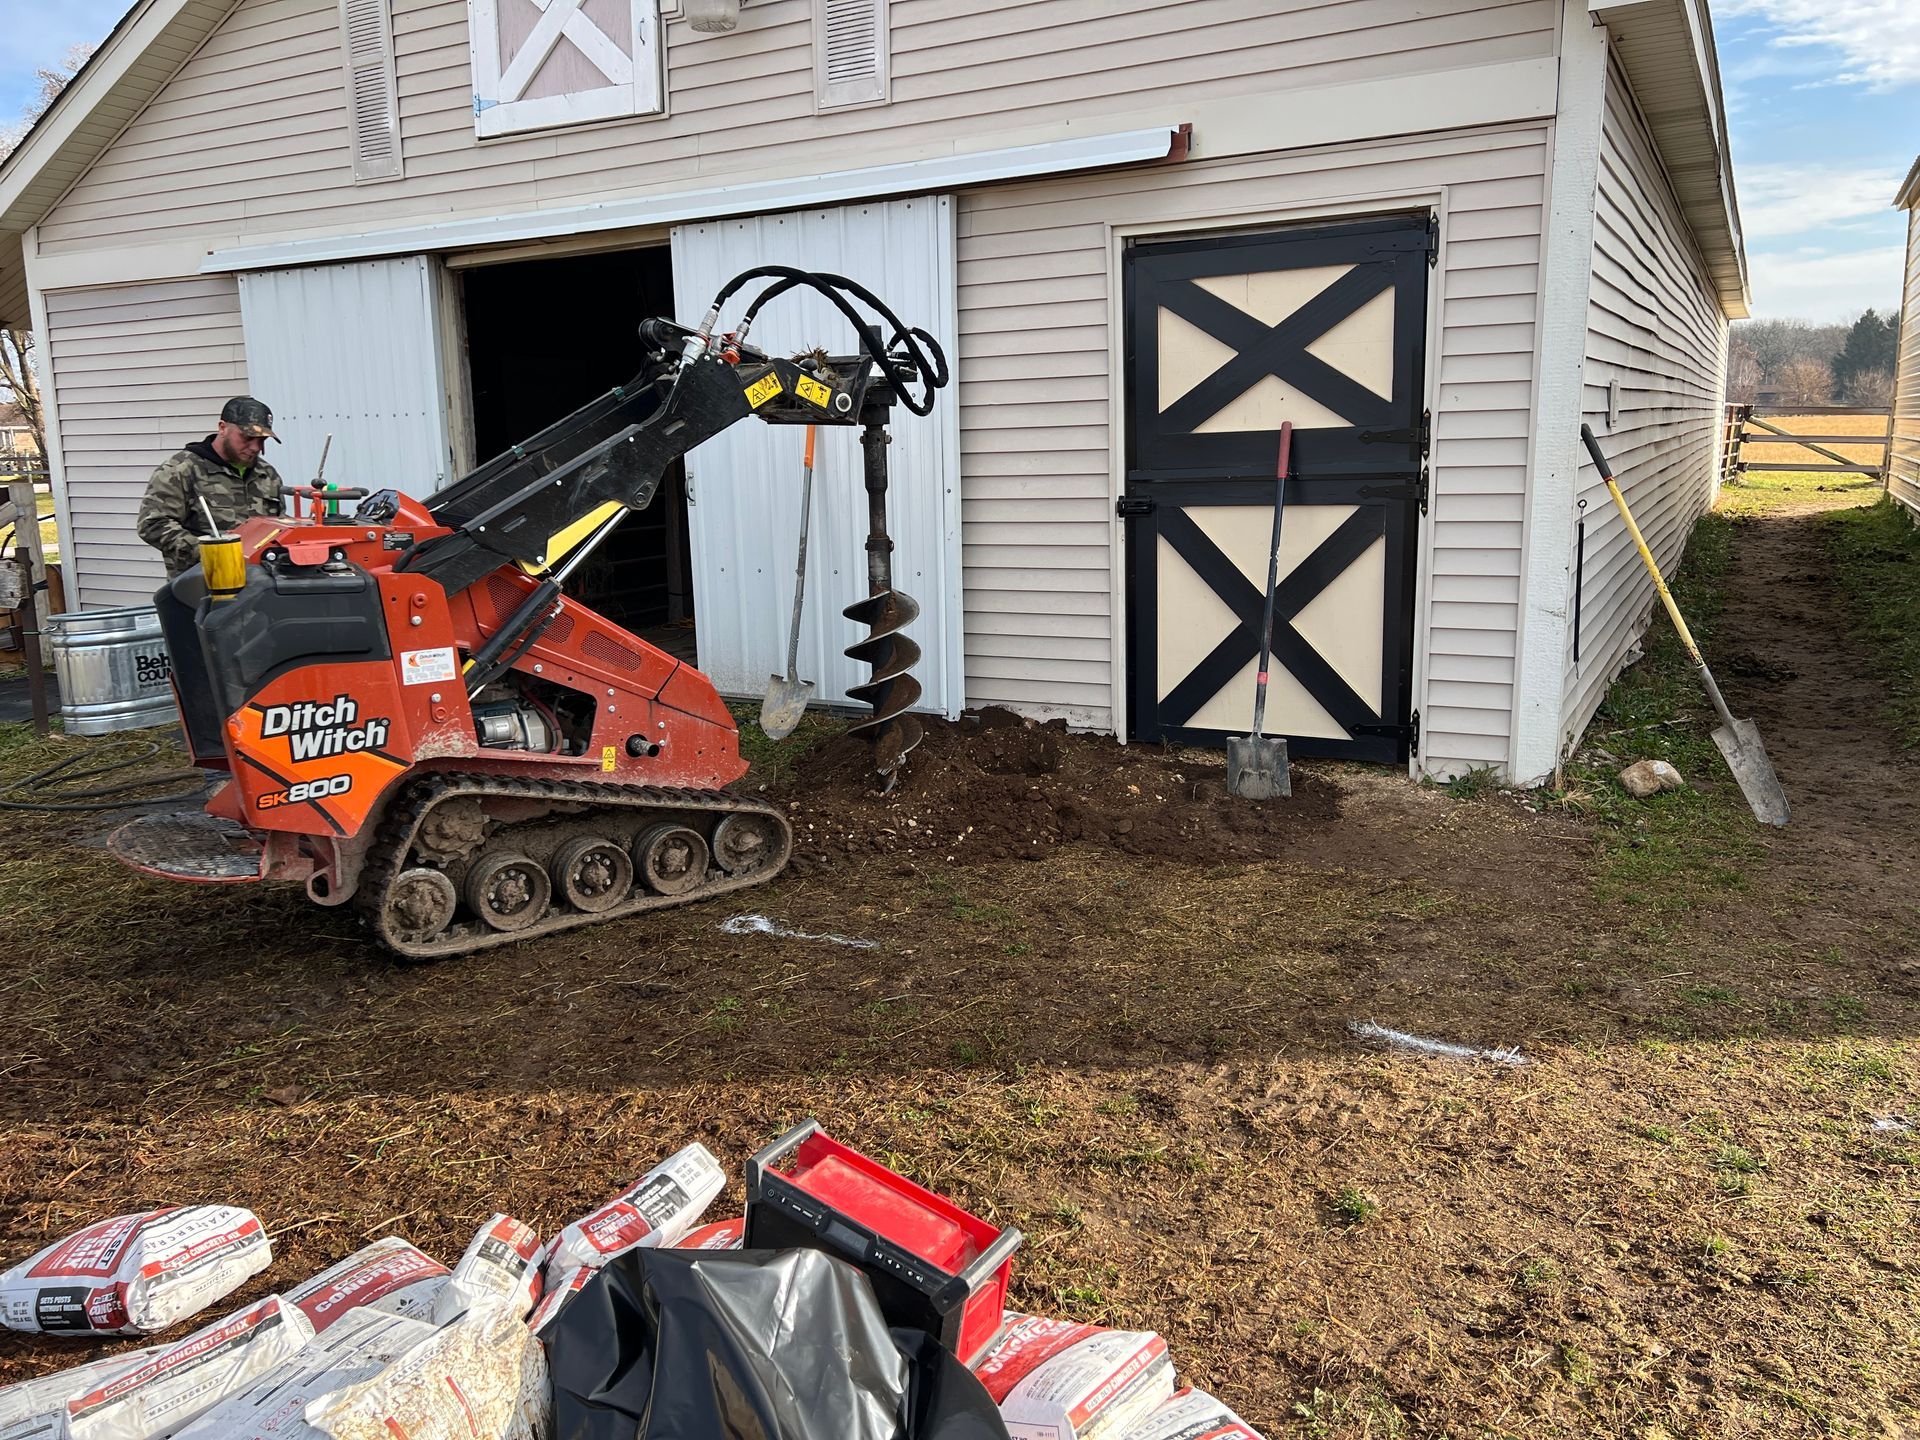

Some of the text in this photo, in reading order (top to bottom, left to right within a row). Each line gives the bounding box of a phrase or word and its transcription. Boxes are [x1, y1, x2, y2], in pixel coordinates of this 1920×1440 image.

[263, 696, 356, 736] Ditch
[258, 775, 351, 809] SK800
[594, 1212, 637, 1241] CONCRETE
[189, 1236, 229, 1257] CONCRETE
[158, 1331, 223, 1369] CONCRETE
[224, 1319, 250, 1337] MIX
[148, 1377, 221, 1417] MASTERCRAFT
